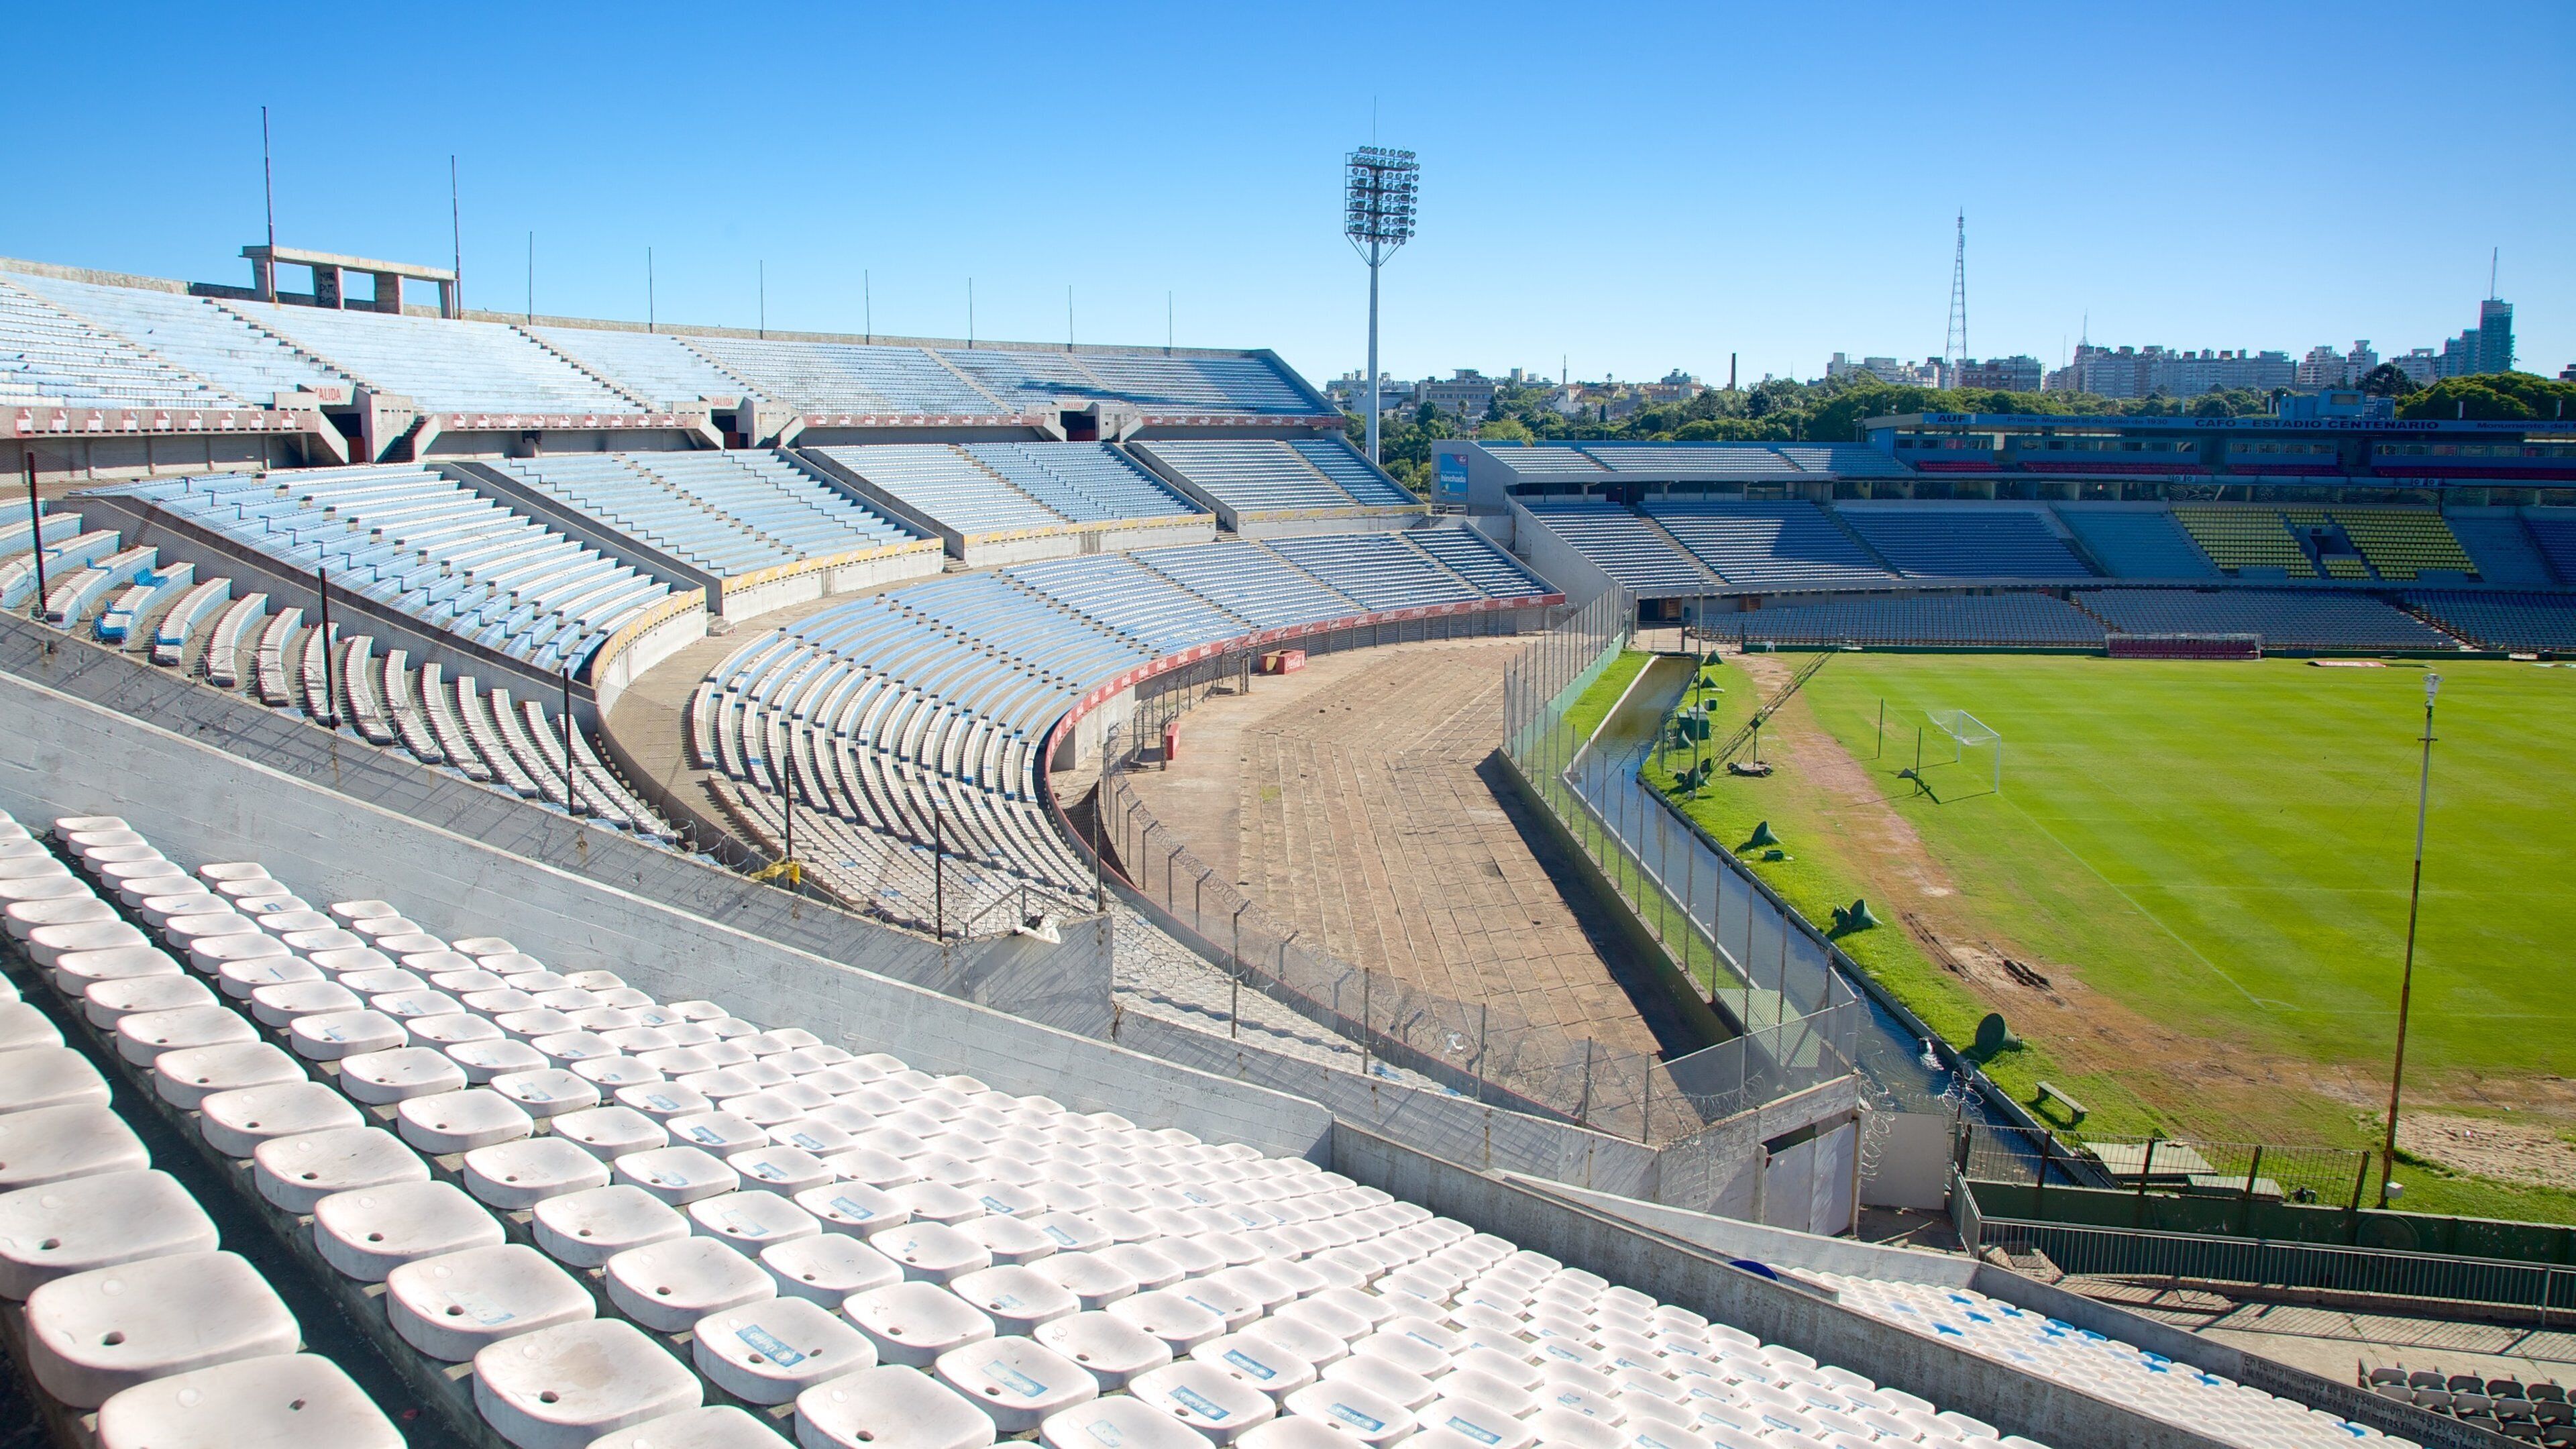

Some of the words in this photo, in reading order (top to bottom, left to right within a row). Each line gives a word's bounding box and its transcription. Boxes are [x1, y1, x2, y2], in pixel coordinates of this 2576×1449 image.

[712, 396, 734, 407] SALIDA
[1937, 415, 1966, 423] AUF
[2195, 419, 2236, 427] CAFO
[2252, 419, 2321, 428] ESTADIO
[2328, 420, 2439, 429] CENTENARIO
[1440, 474, 1466, 483] hinchada
[2244, 1356, 2256, 1367] En
[2259, 1360, 2325, 1392] cumplimiento
[2327, 1381, 2339, 1396] de
[2358, 1407, 2398, 1428] primeras
[2400, 1420, 2422, 1438] filas
